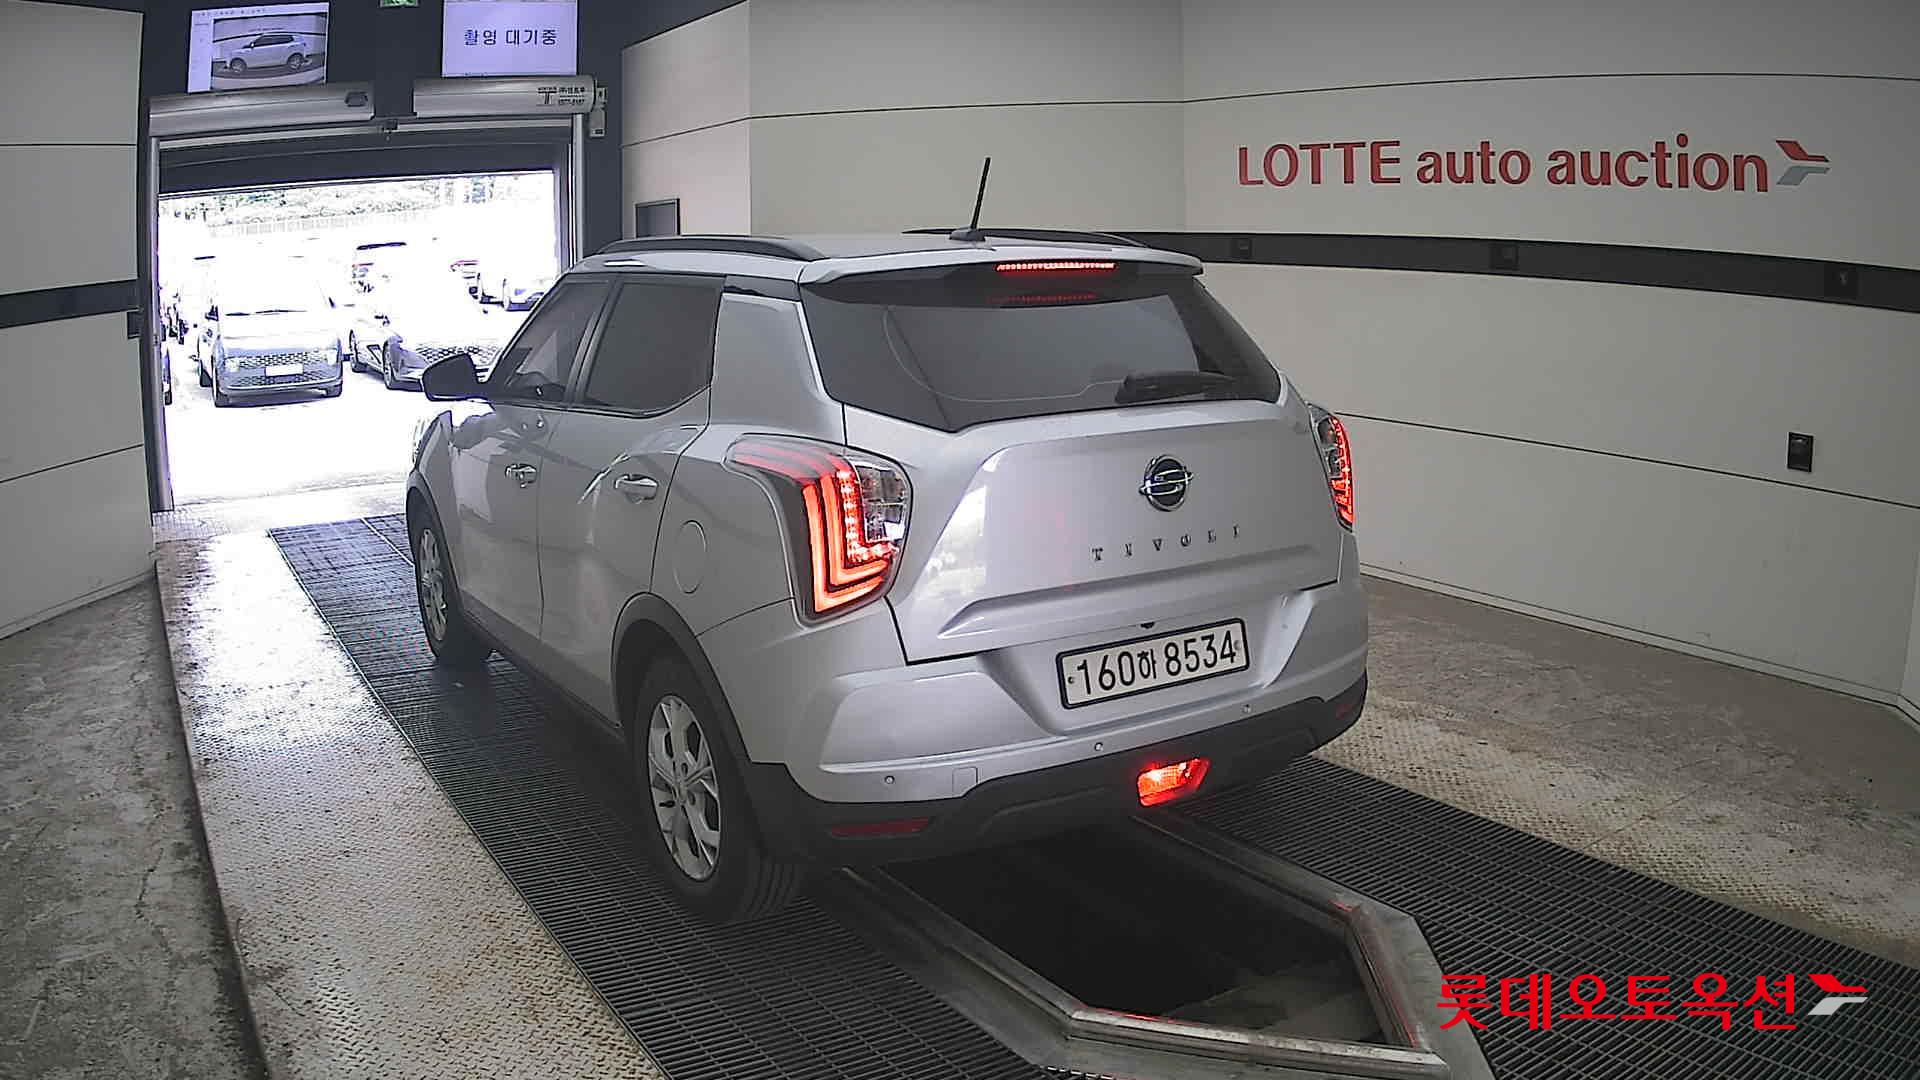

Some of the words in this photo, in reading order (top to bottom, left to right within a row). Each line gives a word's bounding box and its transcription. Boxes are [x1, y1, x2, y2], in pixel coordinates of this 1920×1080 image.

[505, 29, 557, 46] 대기중
[1238, 140, 1400, 187] LOTTE
[1416, 140, 1531, 185] auto
[1546, 134, 1769, 193] auction
[1091, 523, 1241, 562] TIVOLI
[1163, 630, 1237, 677] 8534
